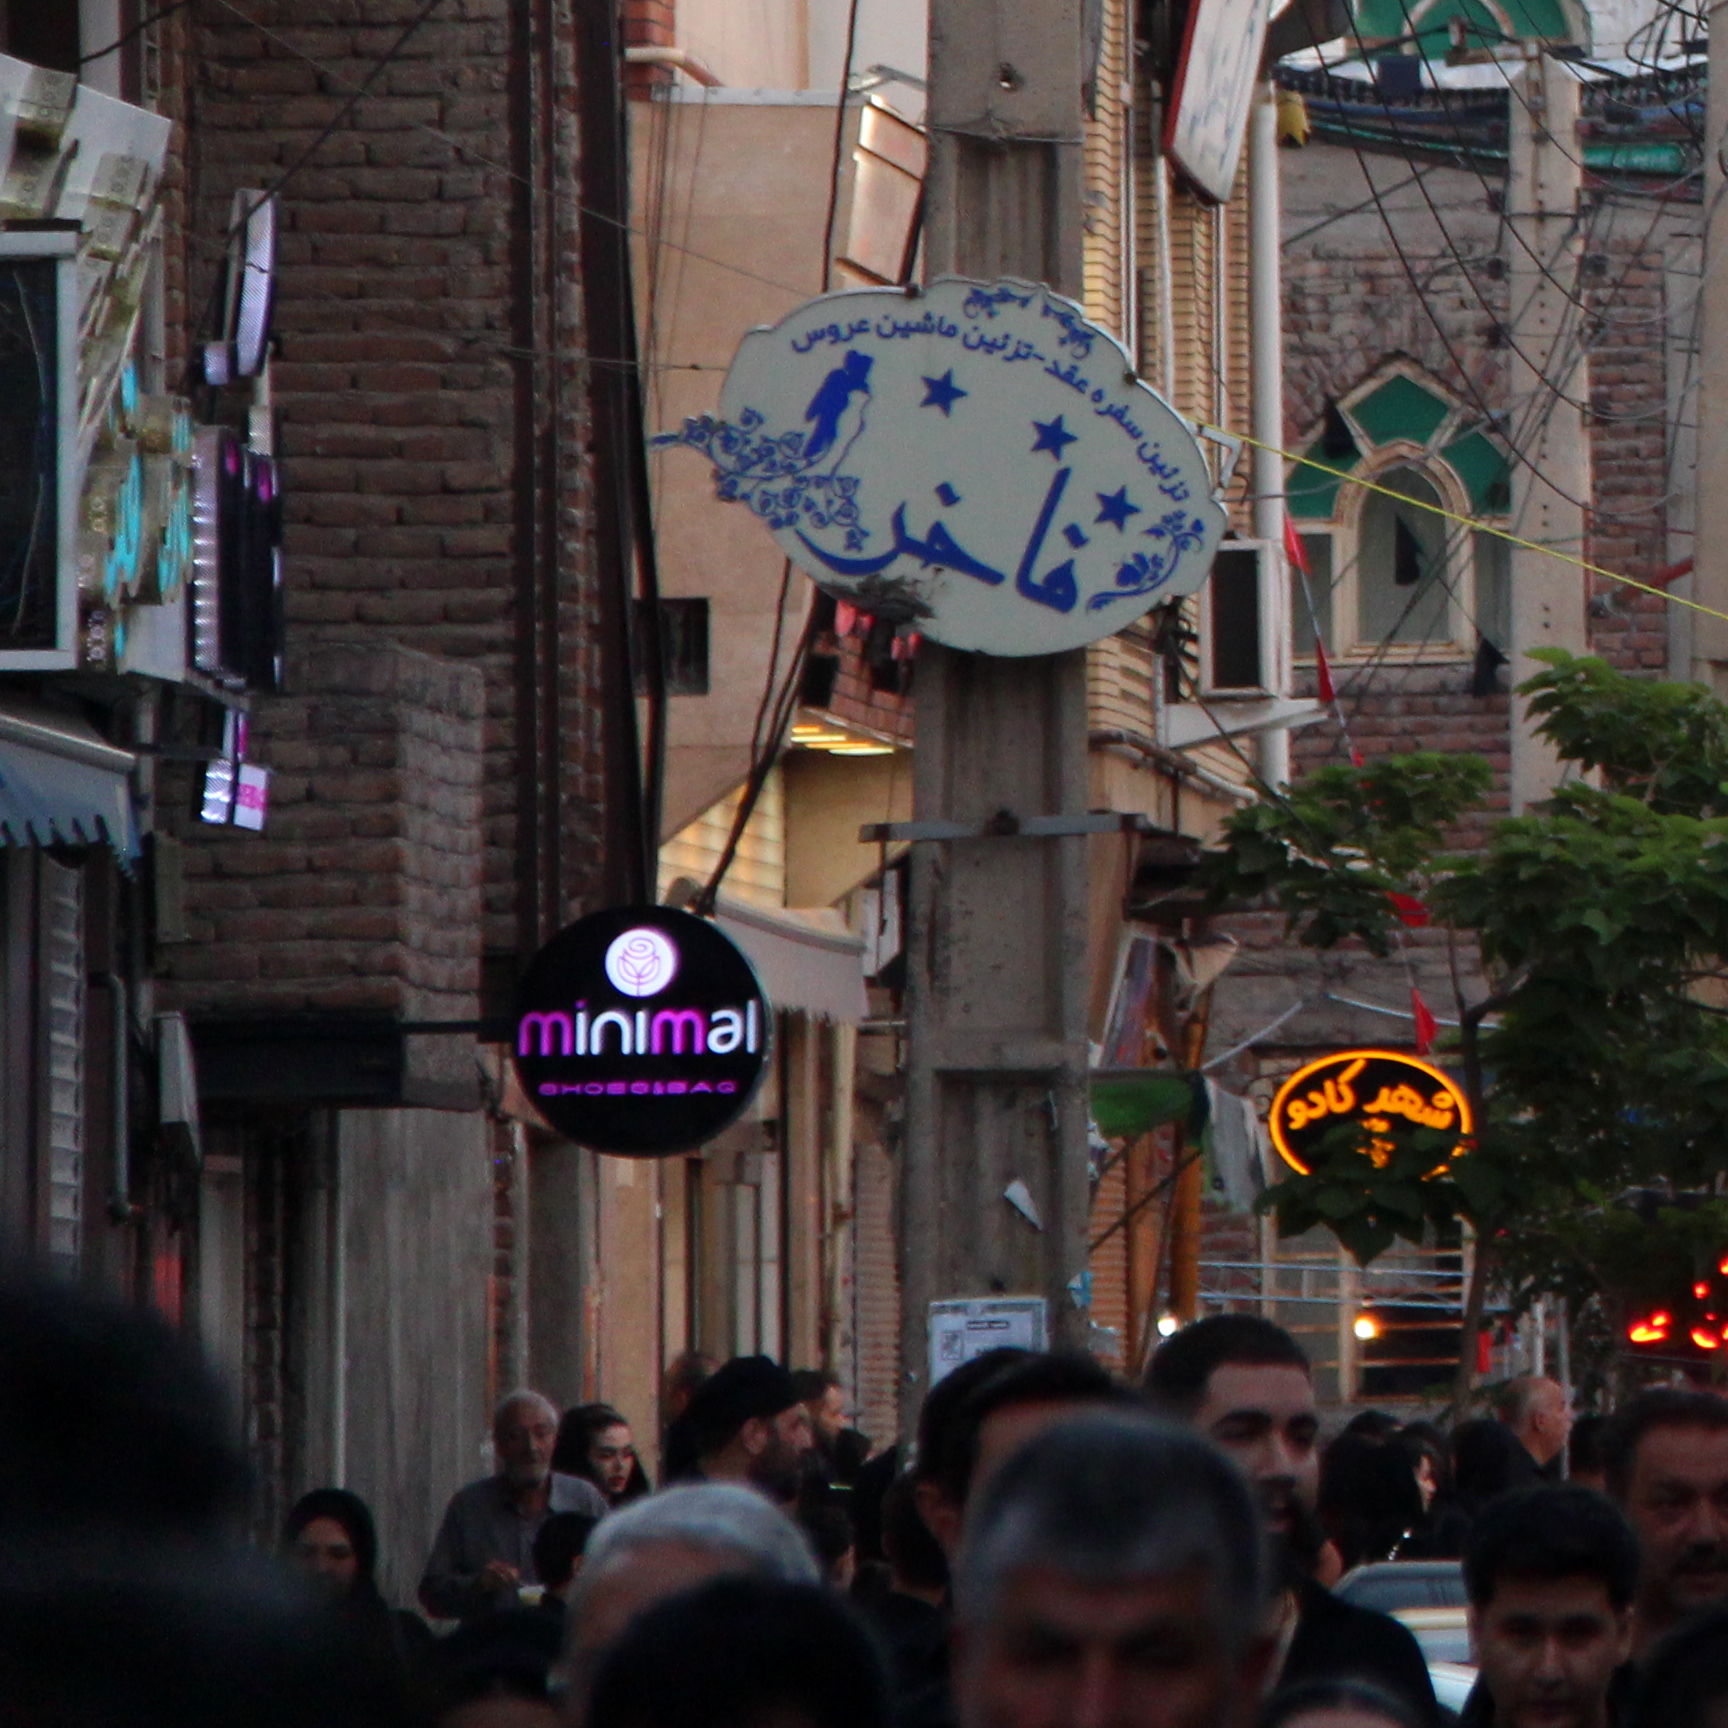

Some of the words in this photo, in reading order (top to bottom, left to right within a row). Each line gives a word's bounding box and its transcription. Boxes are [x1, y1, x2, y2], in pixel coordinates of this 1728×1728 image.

[790, 314, 873, 355] عروس
[875, 310, 959, 340] ماشین
[1090, 387, 1144, 442] سفره
[792, 464, 1091, 616] فاخر
[517, 998, 760, 1057] minimal
[1285, 1058, 1368, 1131] کادو
[1361, 1082, 1456, 1131] شهر
